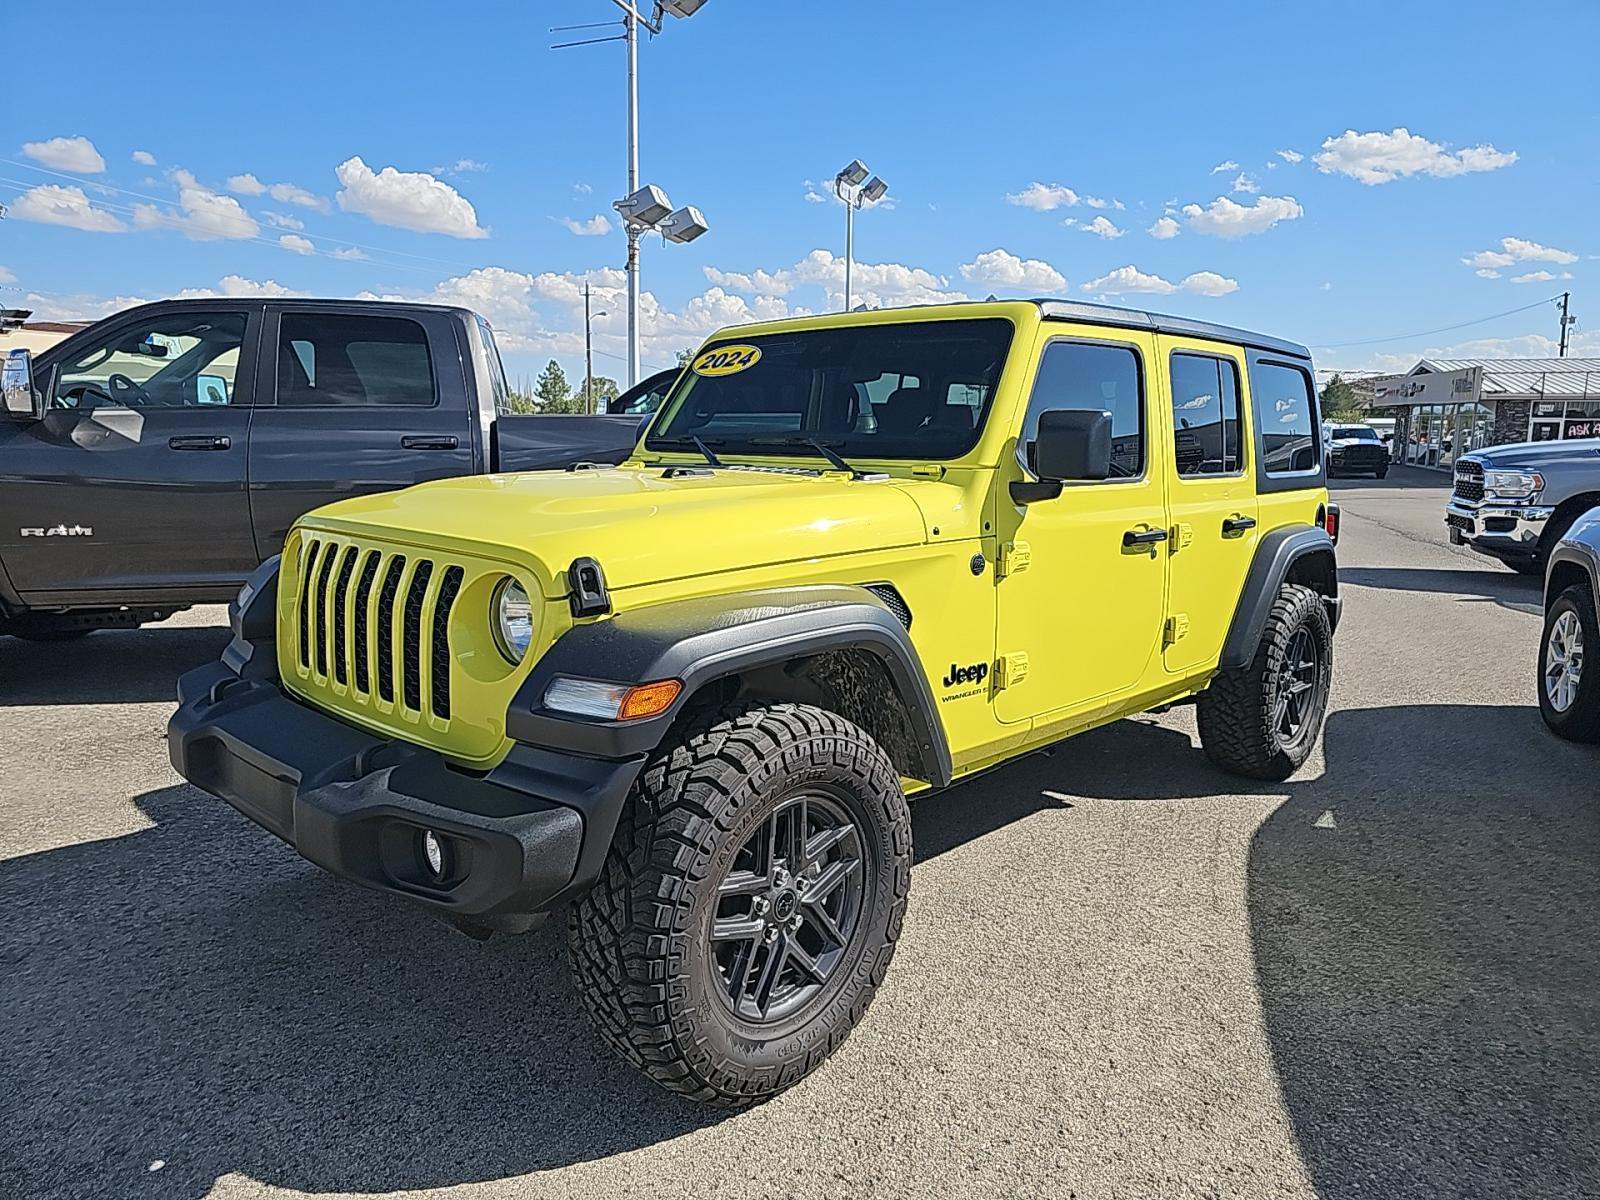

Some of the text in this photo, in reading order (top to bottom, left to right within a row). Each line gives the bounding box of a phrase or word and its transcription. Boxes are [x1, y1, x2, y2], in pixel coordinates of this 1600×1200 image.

[697, 350, 757, 369] 2024
[1568, 423, 1590, 436] ASK
[21, 526, 93, 536] RAM
[943, 662, 988, 687] Jeep
[942, 688, 981, 702] WRANGLER
